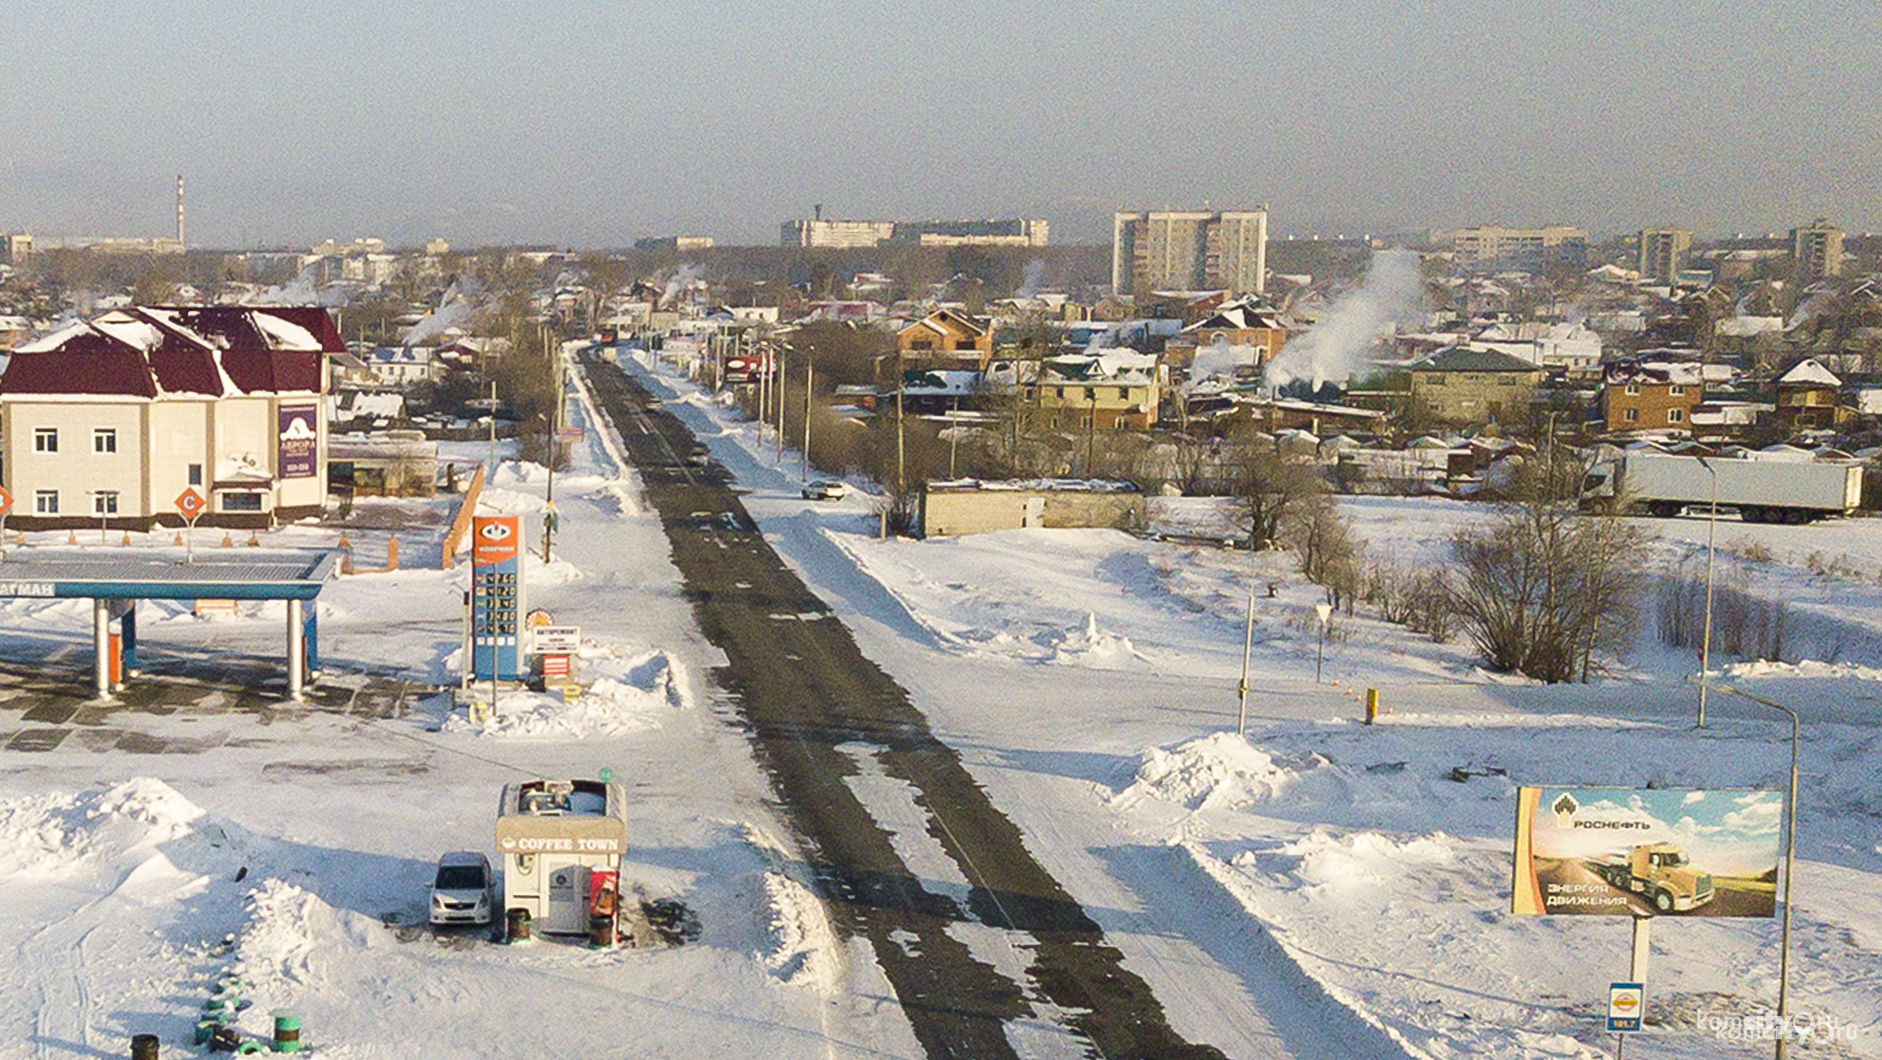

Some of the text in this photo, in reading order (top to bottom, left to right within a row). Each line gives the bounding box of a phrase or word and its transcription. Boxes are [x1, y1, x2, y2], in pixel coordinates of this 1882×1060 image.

[1573, 820, 1651, 830] РОСНЕФТЬ
[518, 838, 619, 851] COFFEE TOWN
[1547, 883, 1609, 894] ЭНЕРГИЯ
[1546, 896, 1628, 907] ДВИЖЕНИЯ
